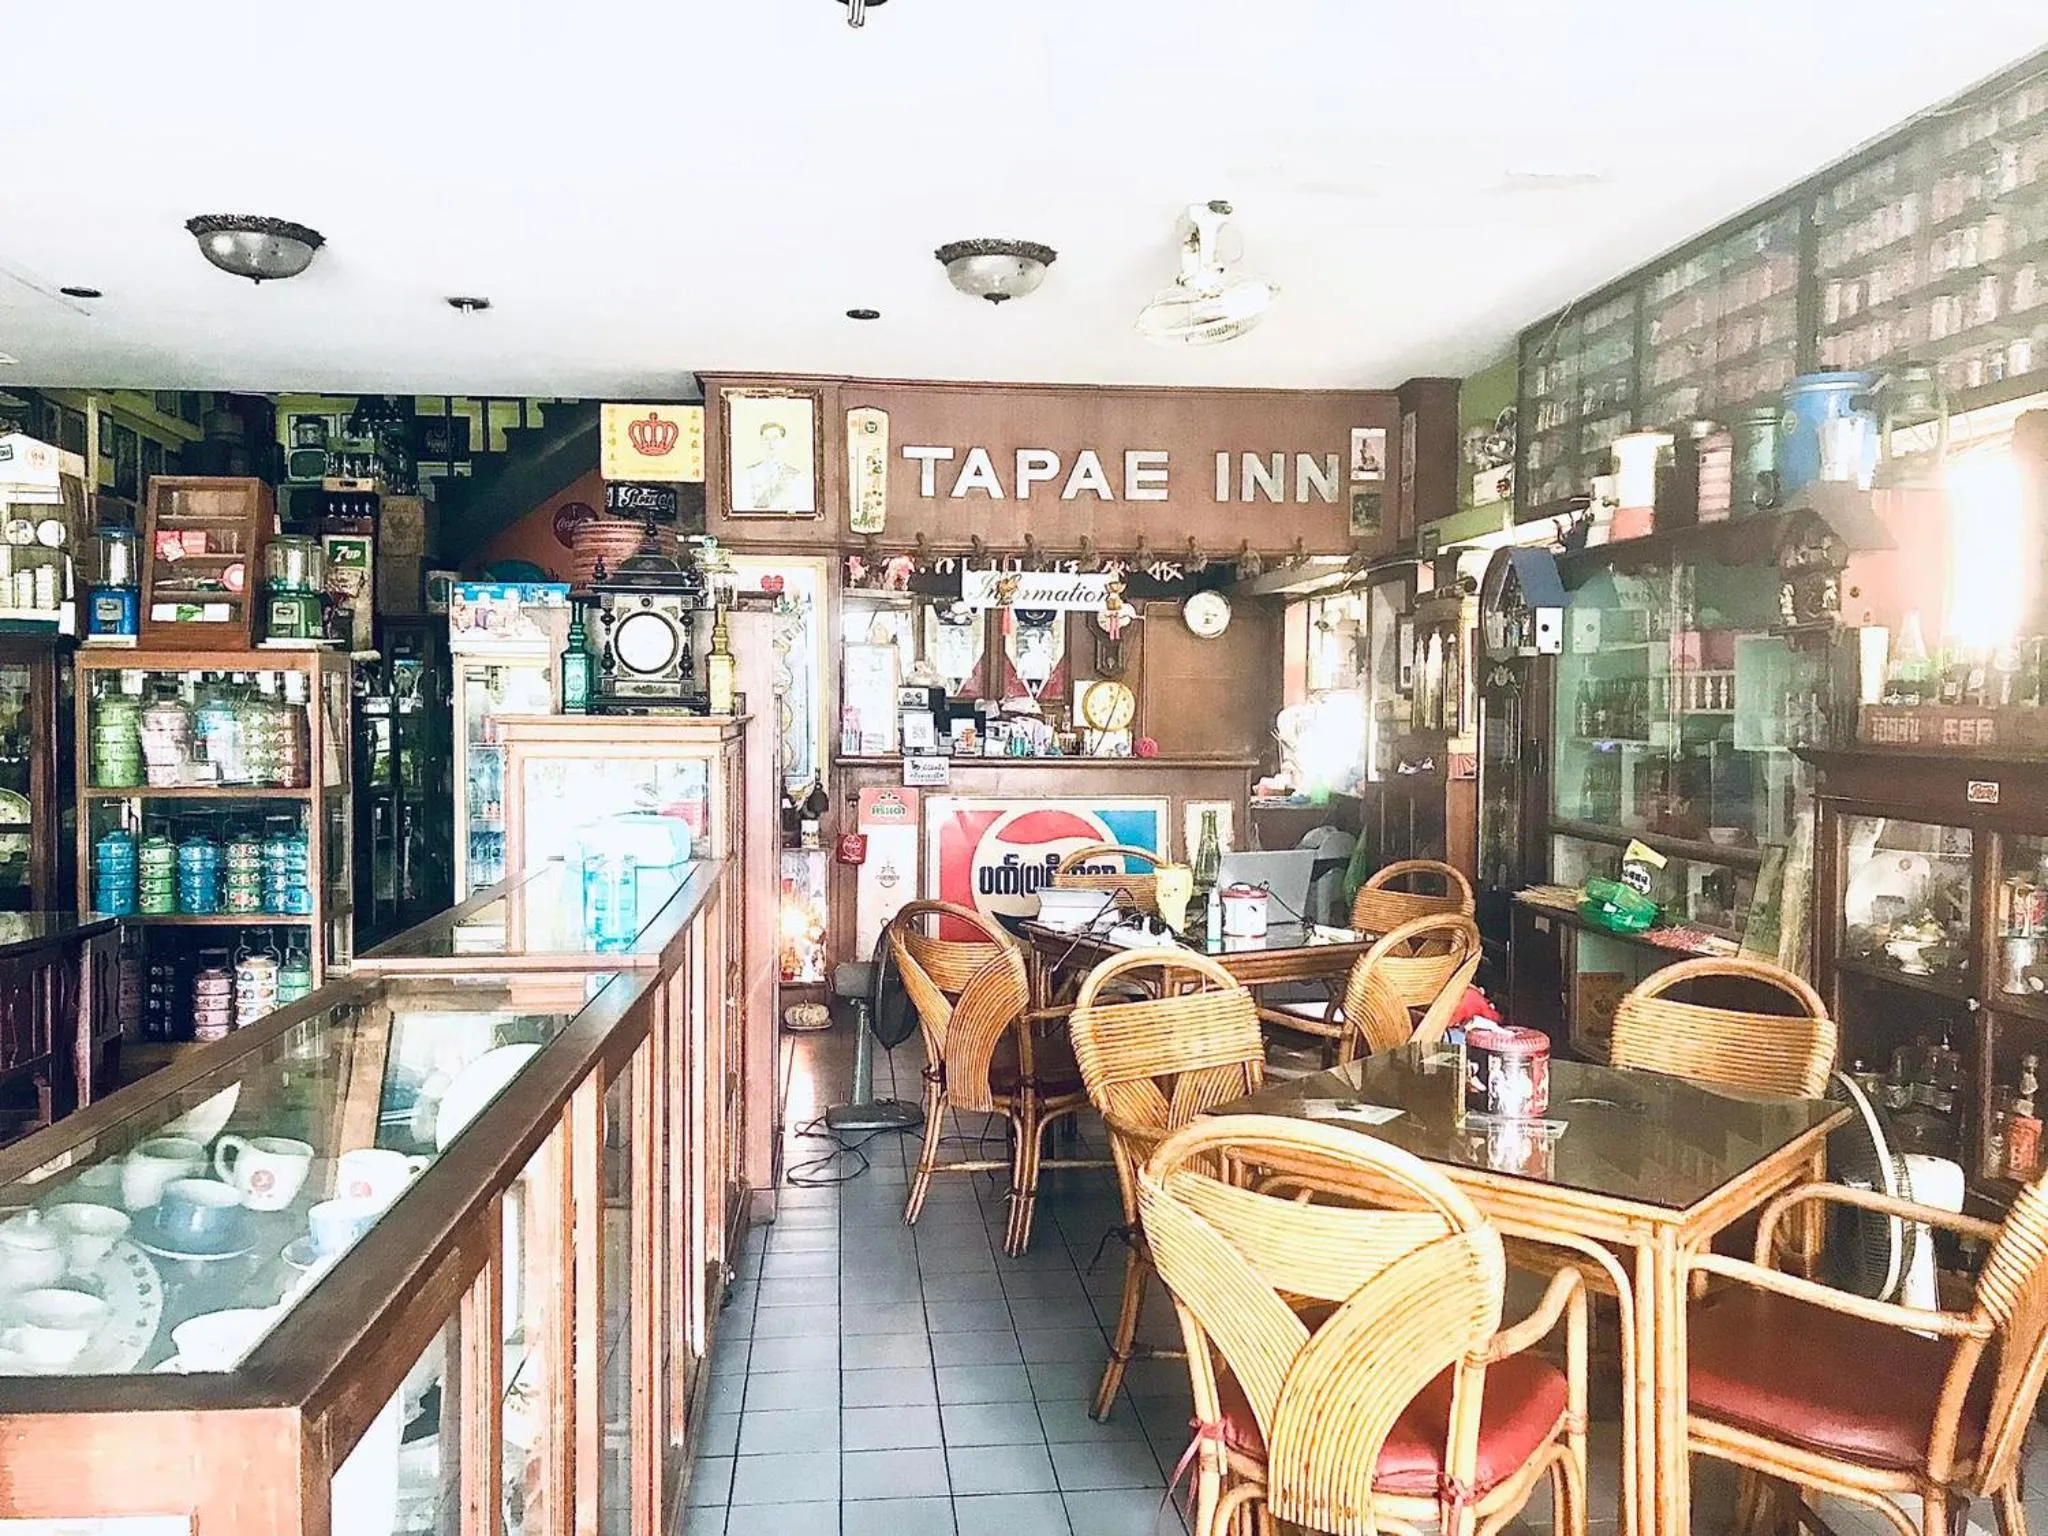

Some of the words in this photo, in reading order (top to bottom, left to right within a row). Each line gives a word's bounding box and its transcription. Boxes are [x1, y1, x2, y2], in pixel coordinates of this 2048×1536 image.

[902, 445, 1169, 502] TAPAE
[1214, 451, 1340, 504] INN
[969, 573, 1109, 606] Infrmation
